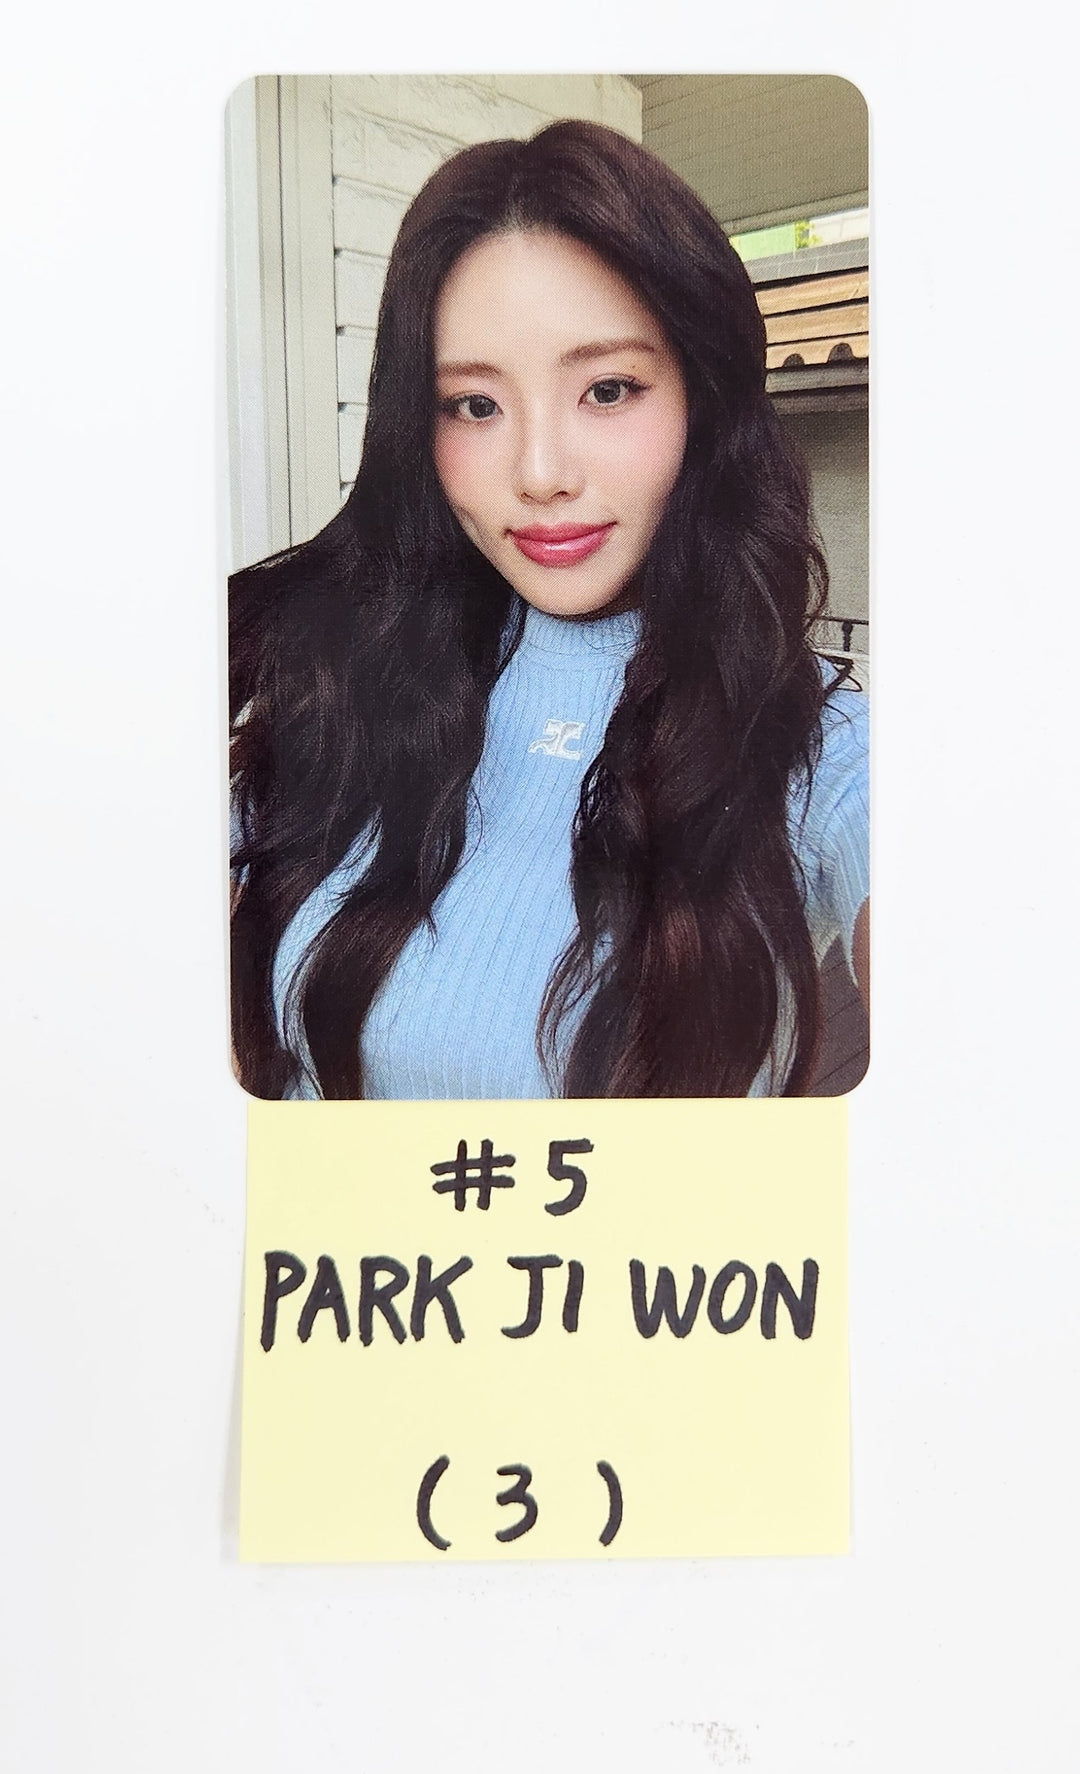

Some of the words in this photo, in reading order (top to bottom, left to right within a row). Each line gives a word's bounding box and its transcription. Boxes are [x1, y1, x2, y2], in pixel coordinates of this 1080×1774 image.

[260, 1250, 474, 1353] PARK
[500, 1254, 585, 1340] JI
[629, 1257, 820, 1341] WON
